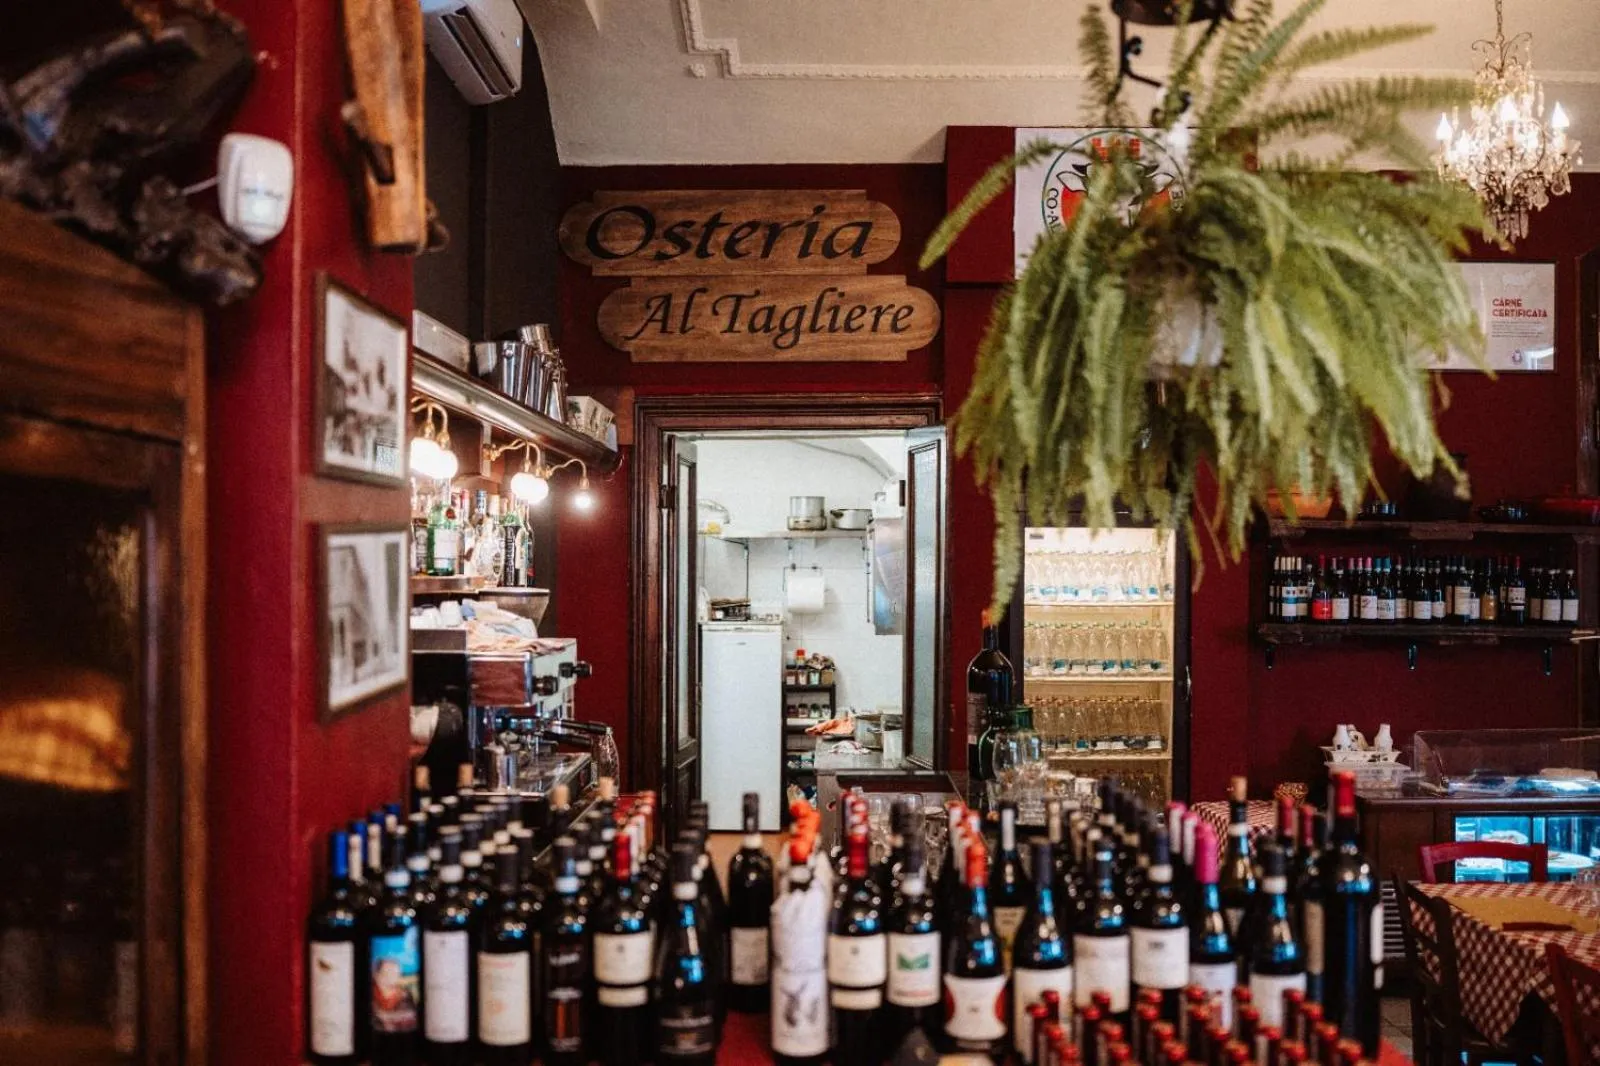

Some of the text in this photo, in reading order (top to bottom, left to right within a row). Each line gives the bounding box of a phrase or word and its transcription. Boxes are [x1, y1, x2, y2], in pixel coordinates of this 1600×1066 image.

[586, 204, 874, 261] Osteria
[623, 287, 914, 349] Al Tagliere
[1492, 298, 1523, 307] CARNE
[1492, 308, 1548, 318] CERTIFICATA
